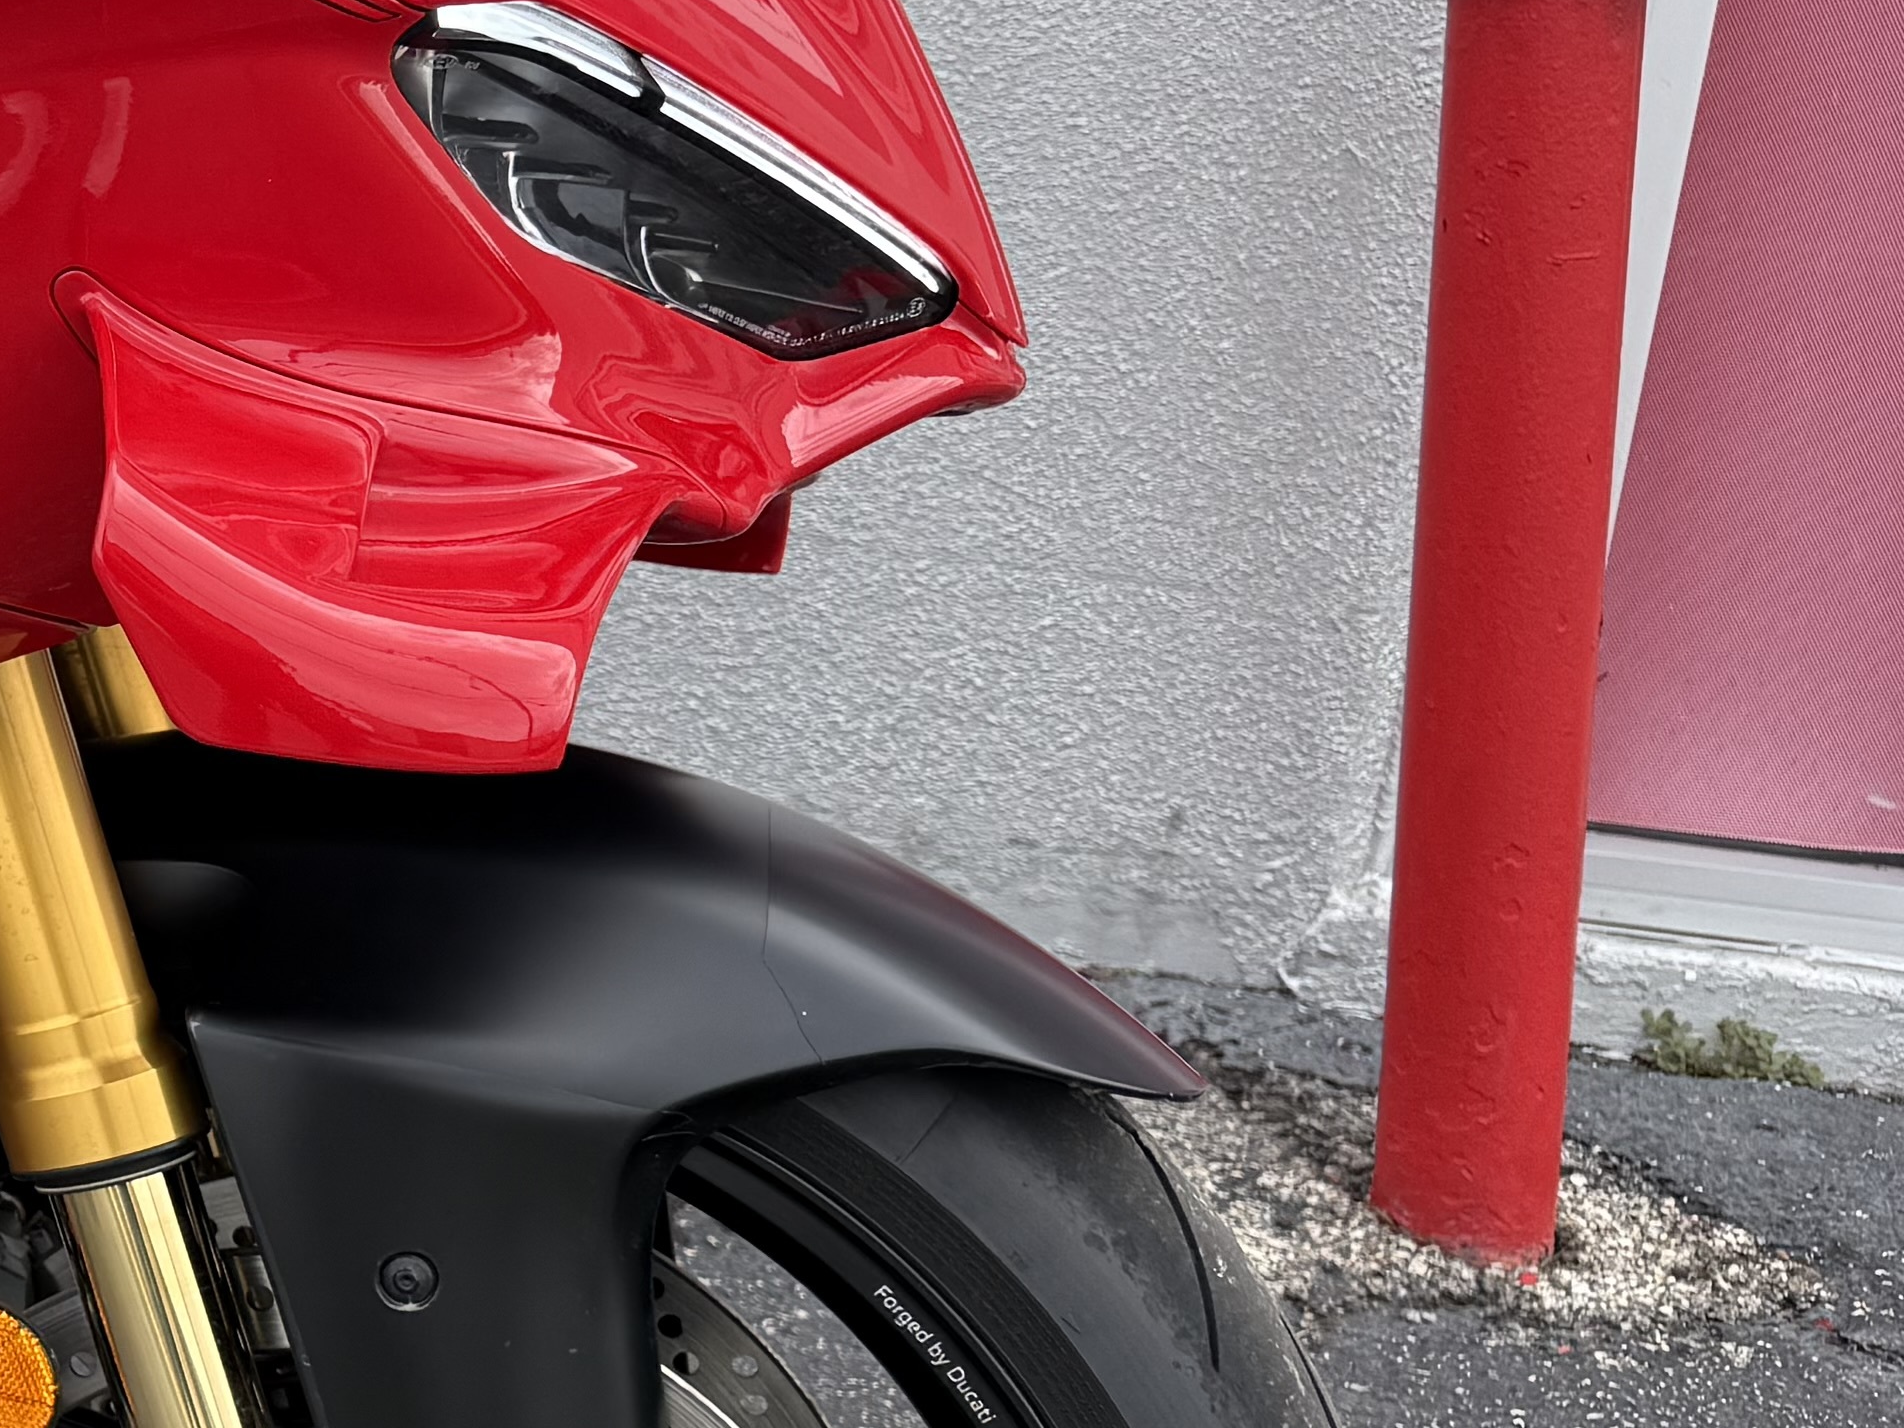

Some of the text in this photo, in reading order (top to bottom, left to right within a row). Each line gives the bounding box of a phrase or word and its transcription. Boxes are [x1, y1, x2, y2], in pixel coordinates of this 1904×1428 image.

[873, 1284, 997, 1424] Forged by Ducati
